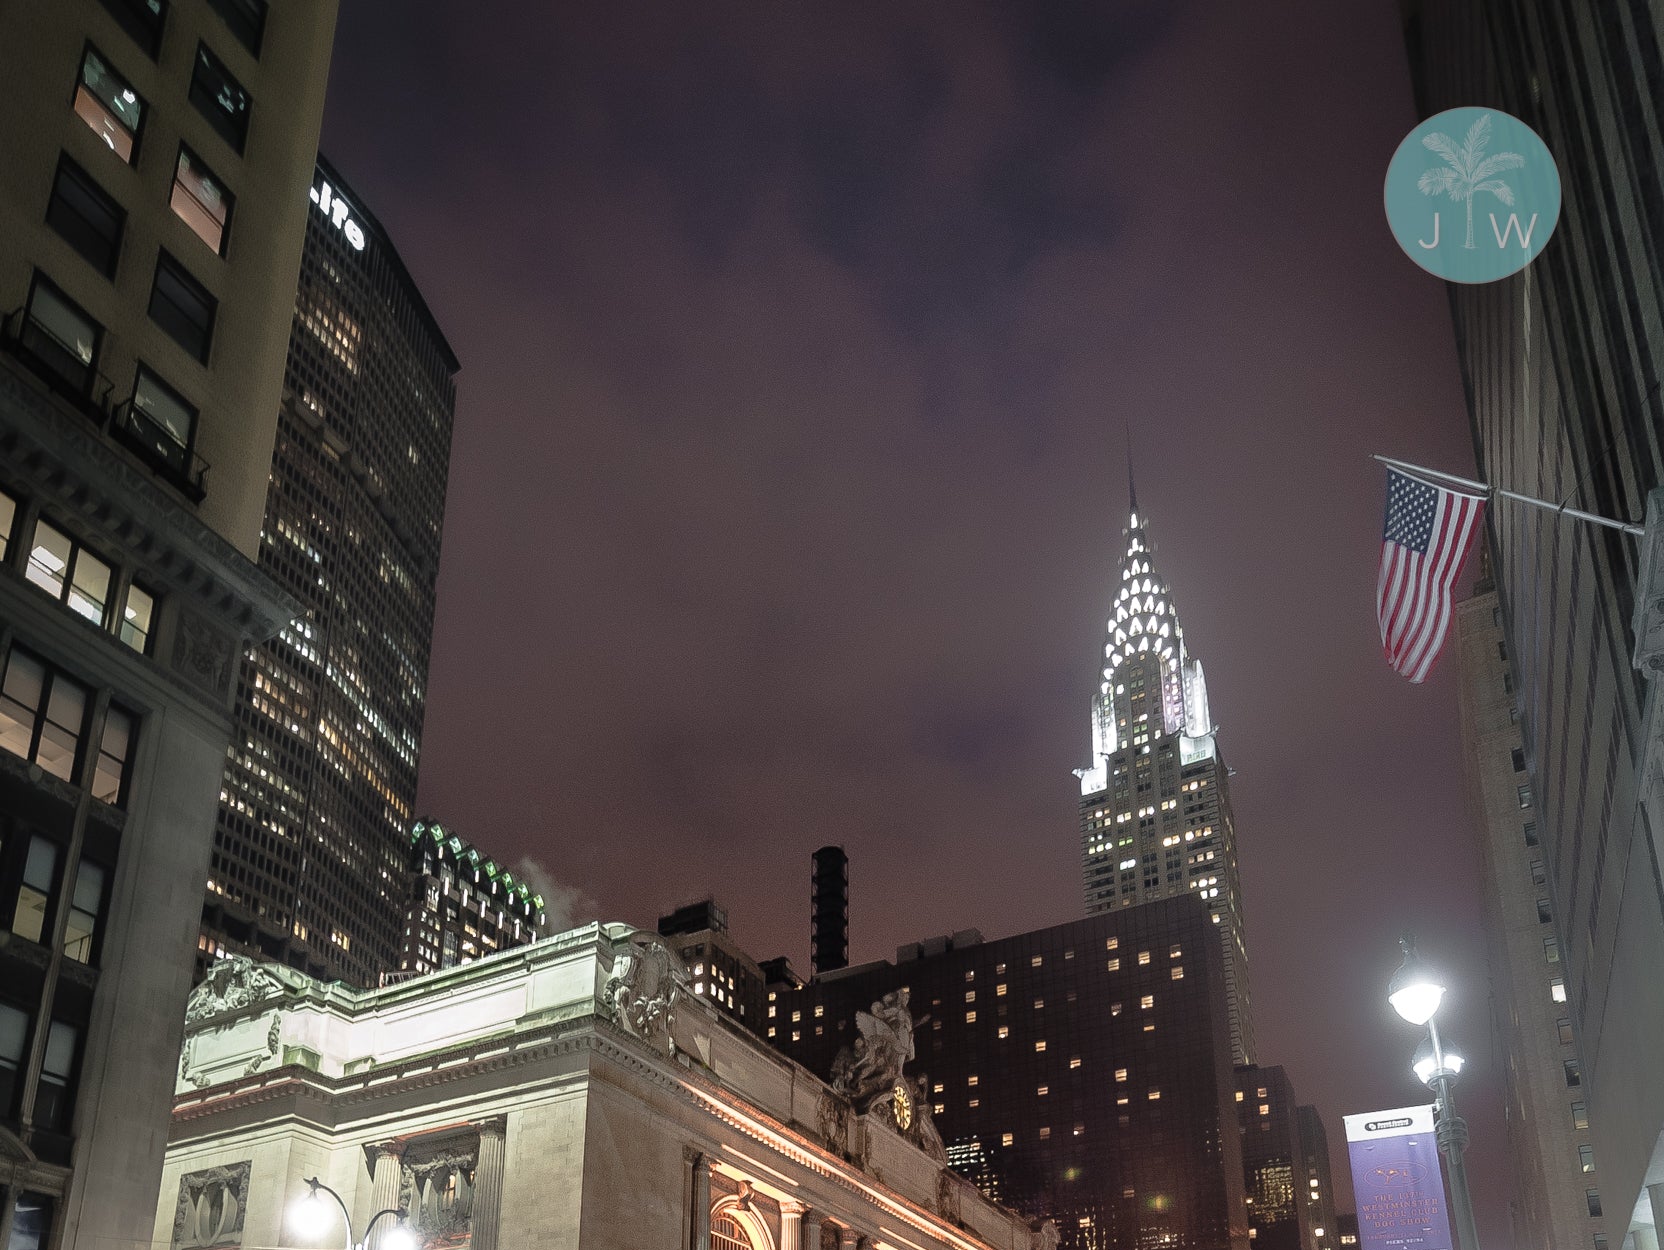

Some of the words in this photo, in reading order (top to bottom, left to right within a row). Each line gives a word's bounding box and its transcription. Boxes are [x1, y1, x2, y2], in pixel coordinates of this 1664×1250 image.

[1362, 1198, 1438, 1212] WESTMINSTER
[1365, 1210, 1406, 1221] KENNEL
[1374, 1220, 1395, 1228] DOG
[1400, 1217, 1431, 1226] SHOW
